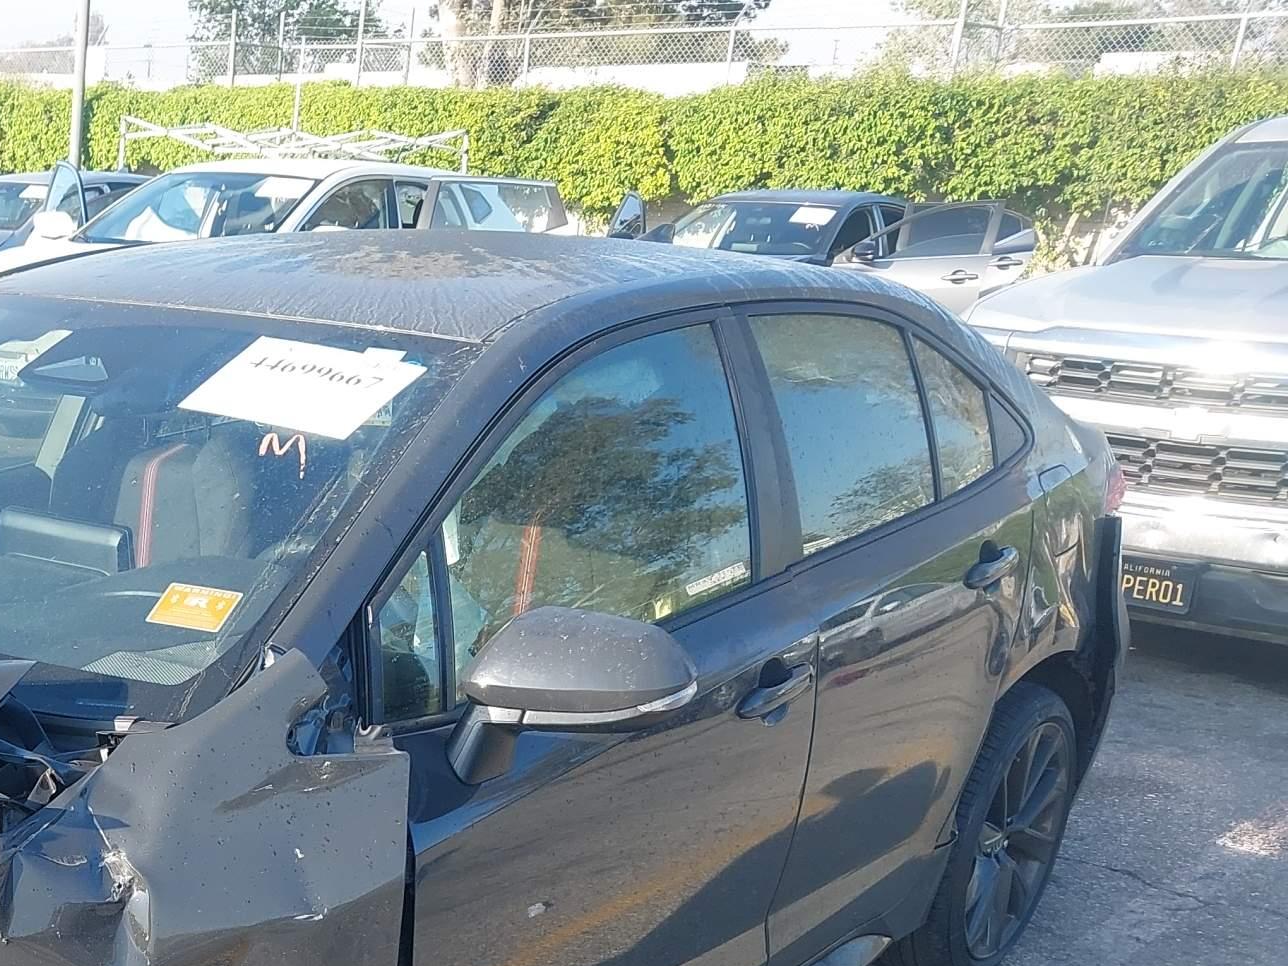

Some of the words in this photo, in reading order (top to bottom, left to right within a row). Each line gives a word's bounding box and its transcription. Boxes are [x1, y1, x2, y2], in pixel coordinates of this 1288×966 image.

[249, 356, 384, 389] 44699667
[258, 432, 307, 480] M
[1123, 562, 1171, 577] ALIFORNIA
[1121, 574, 1184, 606] PER01
